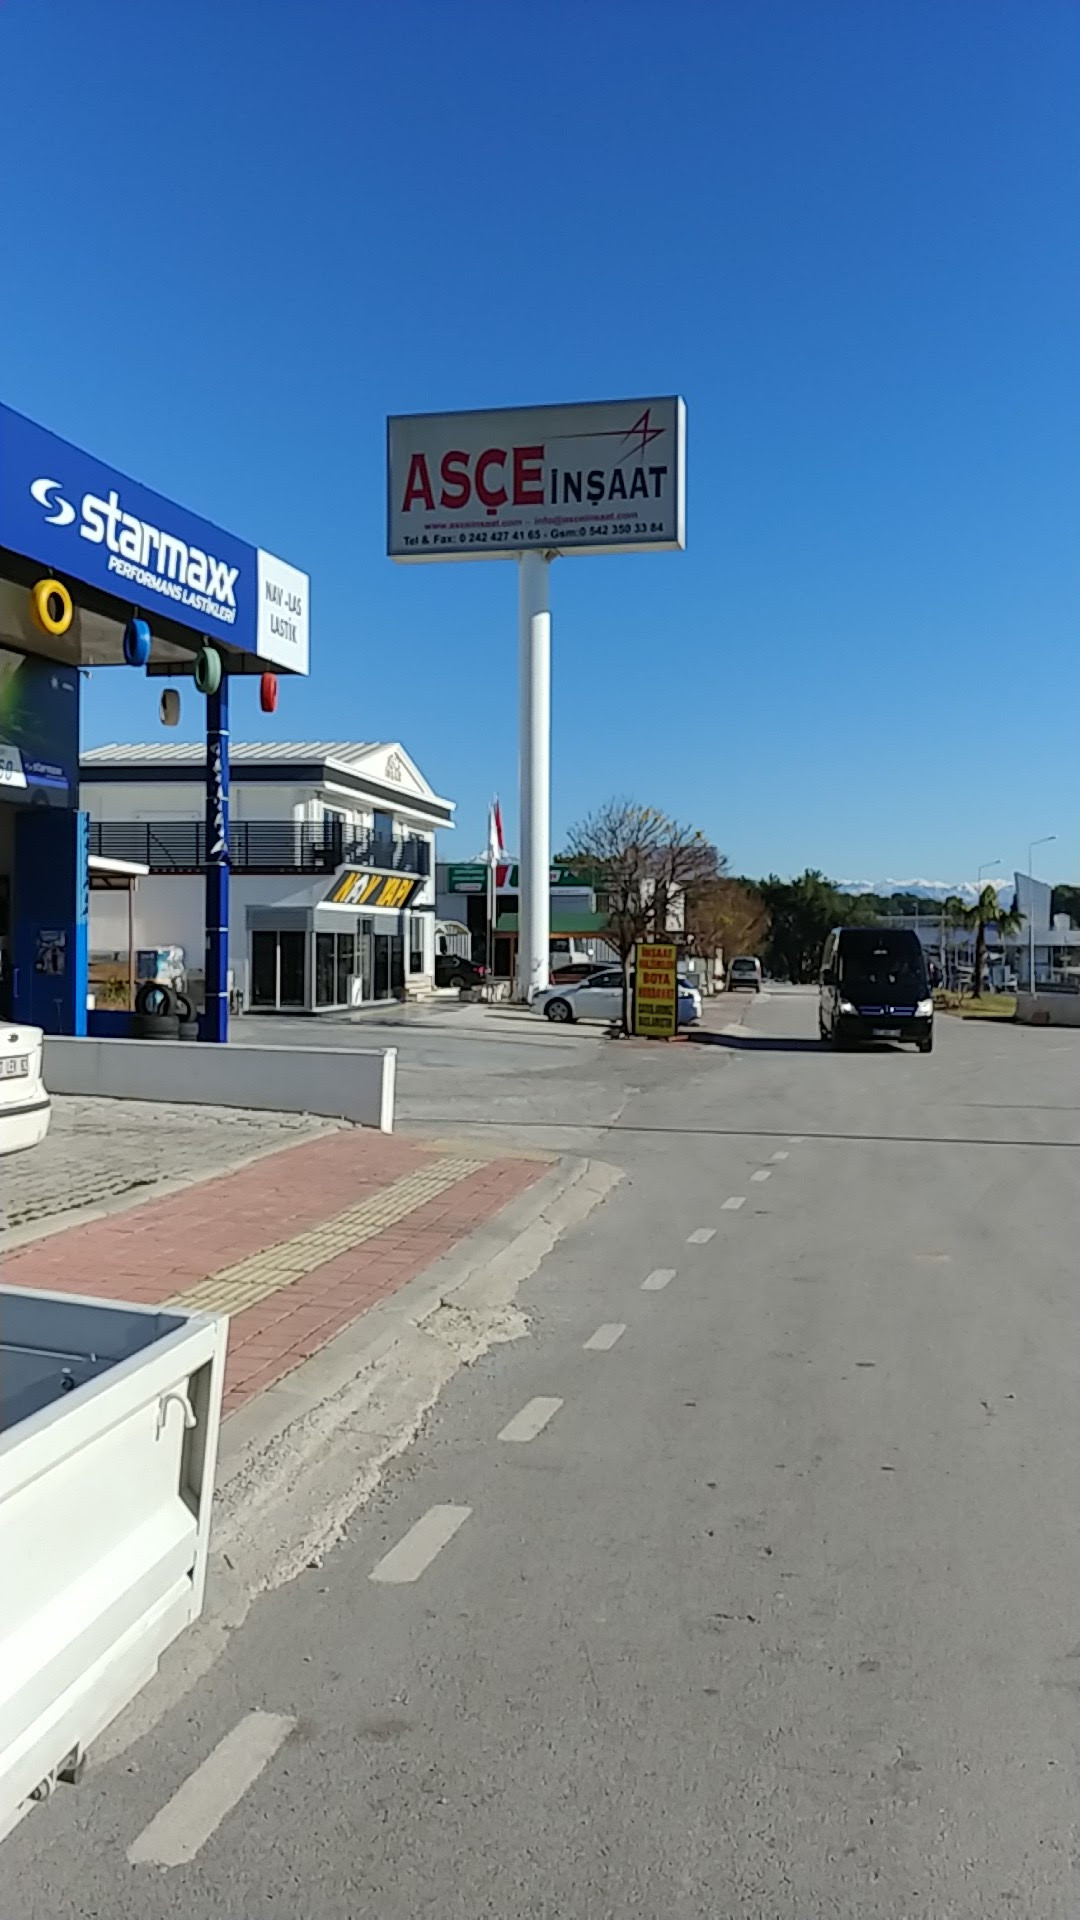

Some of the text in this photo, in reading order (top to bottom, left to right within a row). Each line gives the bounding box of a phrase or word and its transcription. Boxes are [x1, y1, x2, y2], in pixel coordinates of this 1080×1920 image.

[402, 446, 667, 515] ASÇE İNŞAAT
[80, 490, 239, 607] starmaxx
[404, 535, 418, 545] Tel
[421, 535, 429, 544] &
[459, 533, 466, 543] 0
[469, 532, 487, 542] 242
[491, 531, 509, 541] 427
[512, 530, 524, 540] 41
[528, 529, 541, 539] 65
[589, 525, 608, 535] 542
[612, 523, 631, 534] 350
[634, 522, 647, 533] 33
[108, 554, 183, 601] PERFORMANS
[270, 613, 298, 644] LASTİK
